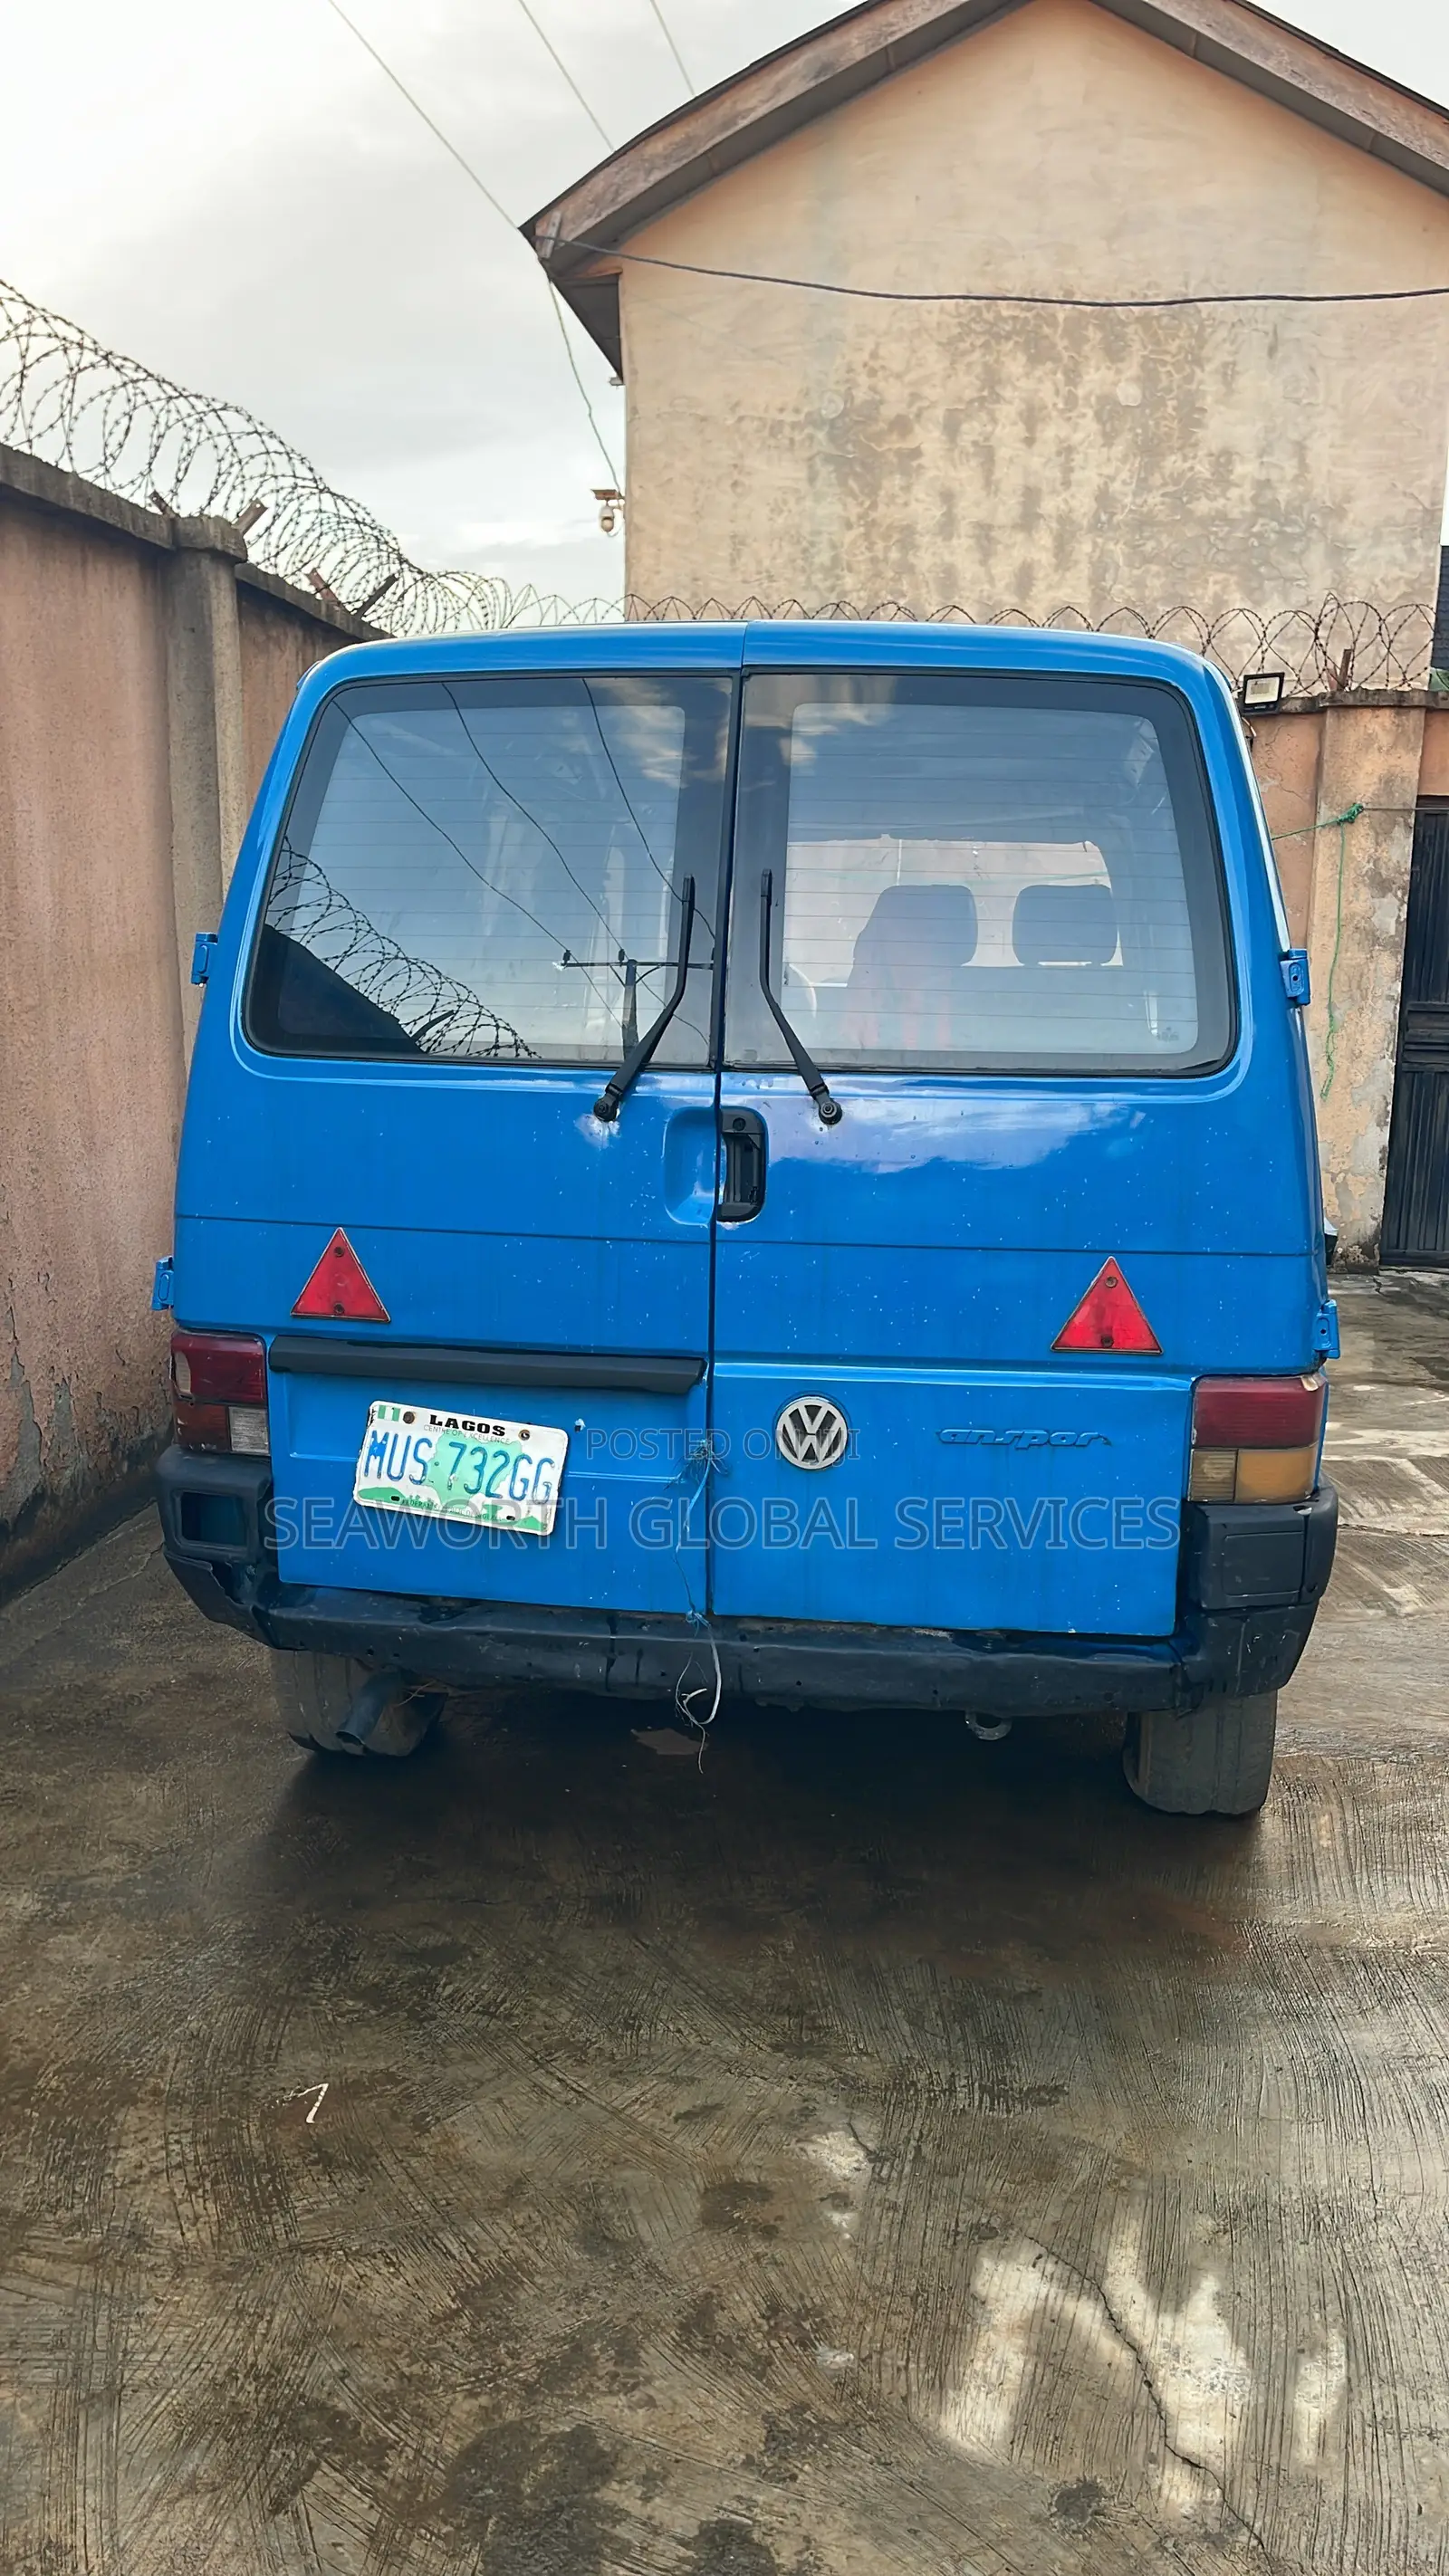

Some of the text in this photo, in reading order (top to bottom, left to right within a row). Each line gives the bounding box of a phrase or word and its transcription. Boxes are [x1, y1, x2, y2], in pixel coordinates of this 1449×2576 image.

[423, 1424, 450, 1435] CENTRE
[429, 1414, 506, 1437] LAGOS
[364, 1430, 555, 1506] MUS 732GG
